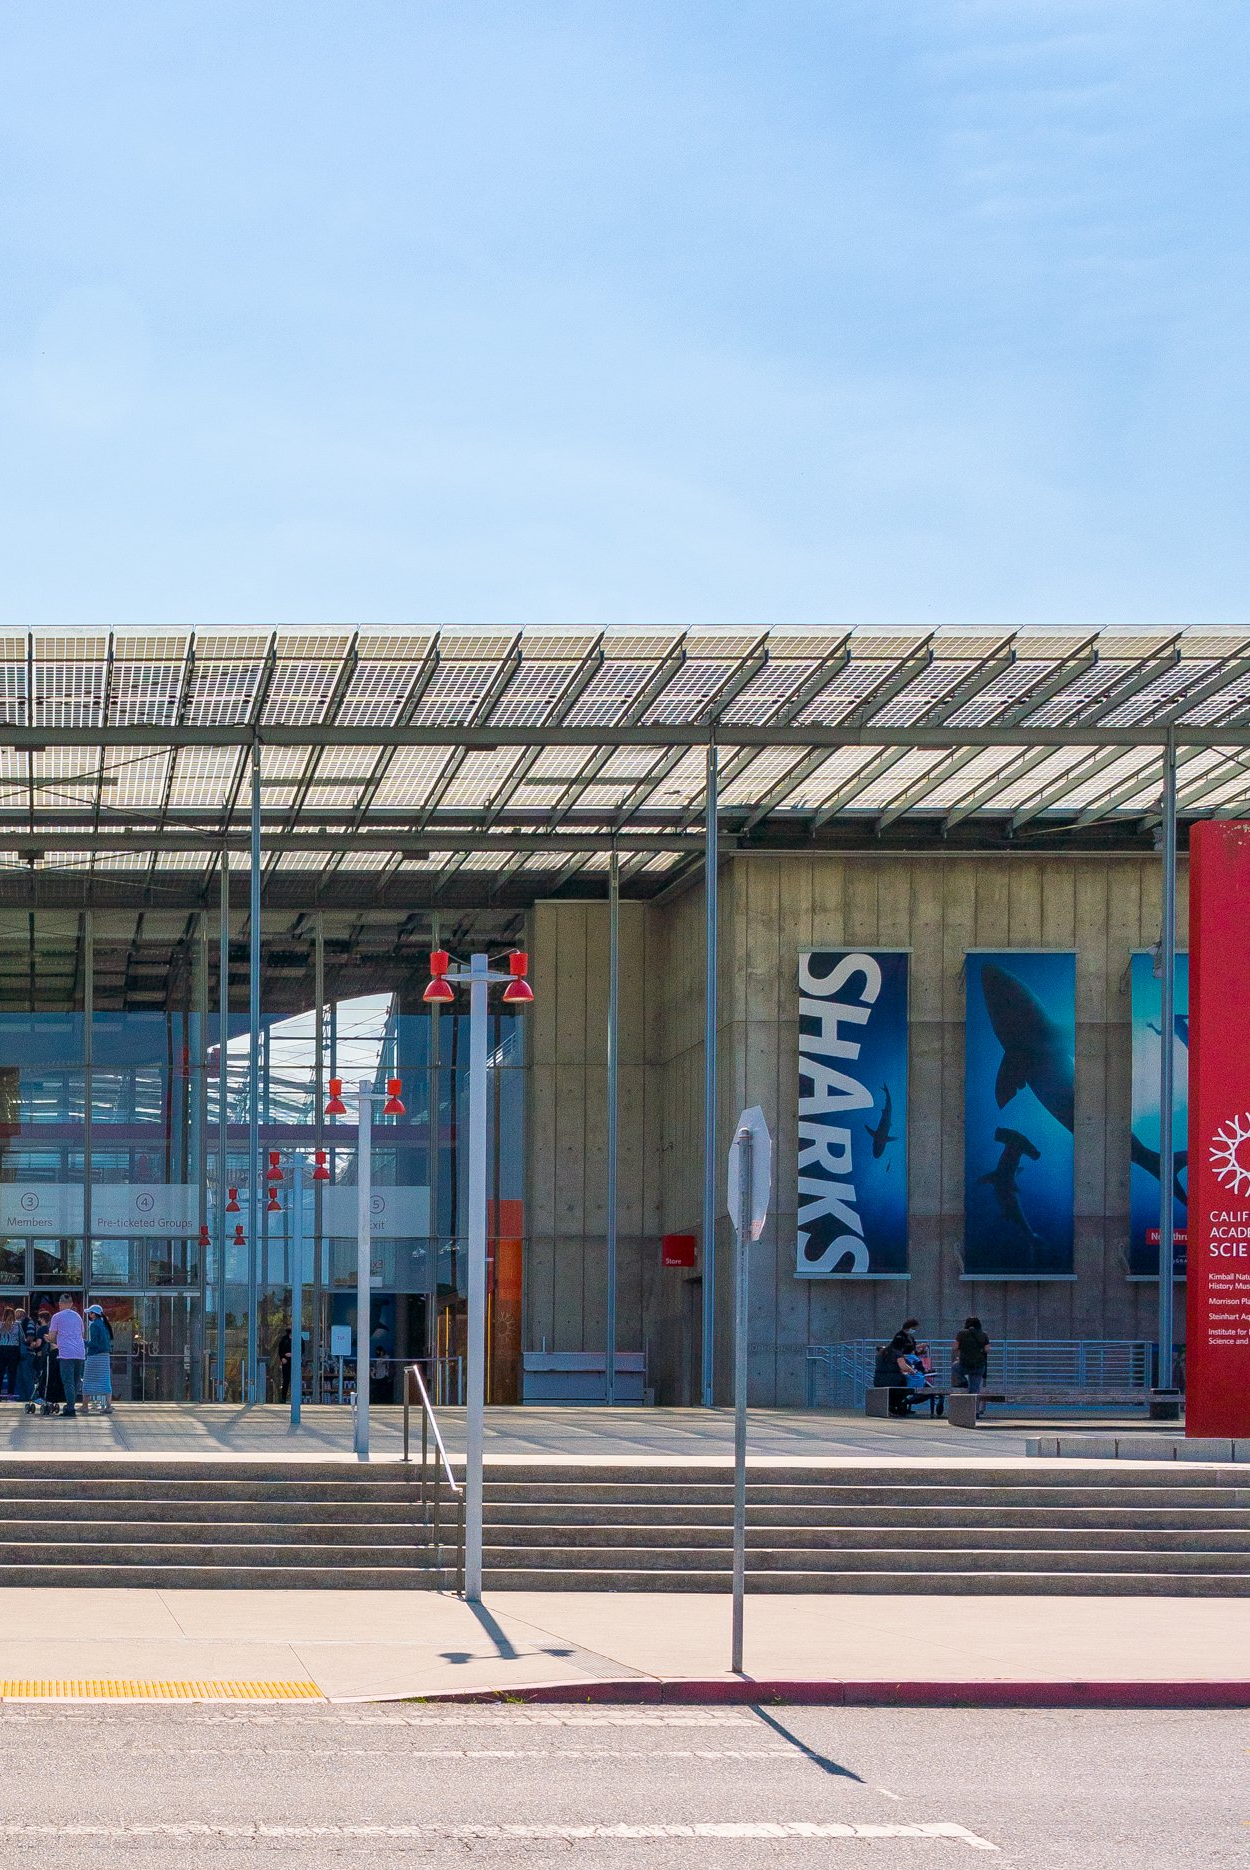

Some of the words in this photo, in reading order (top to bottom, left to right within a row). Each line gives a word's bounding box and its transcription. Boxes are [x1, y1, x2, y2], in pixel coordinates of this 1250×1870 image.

[796, 952, 882, 1273] SHARKS
[7, 1217, 53, 1226] Members
[1210, 1211, 1249, 1222] CALIF
[97, 1217, 155, 1227] Pre-ticketed
[157, 1217, 193, 1229] Groups
[1209, 1243, 1248, 1257] SCIE
[1208, 1282, 1234, 1290] History
